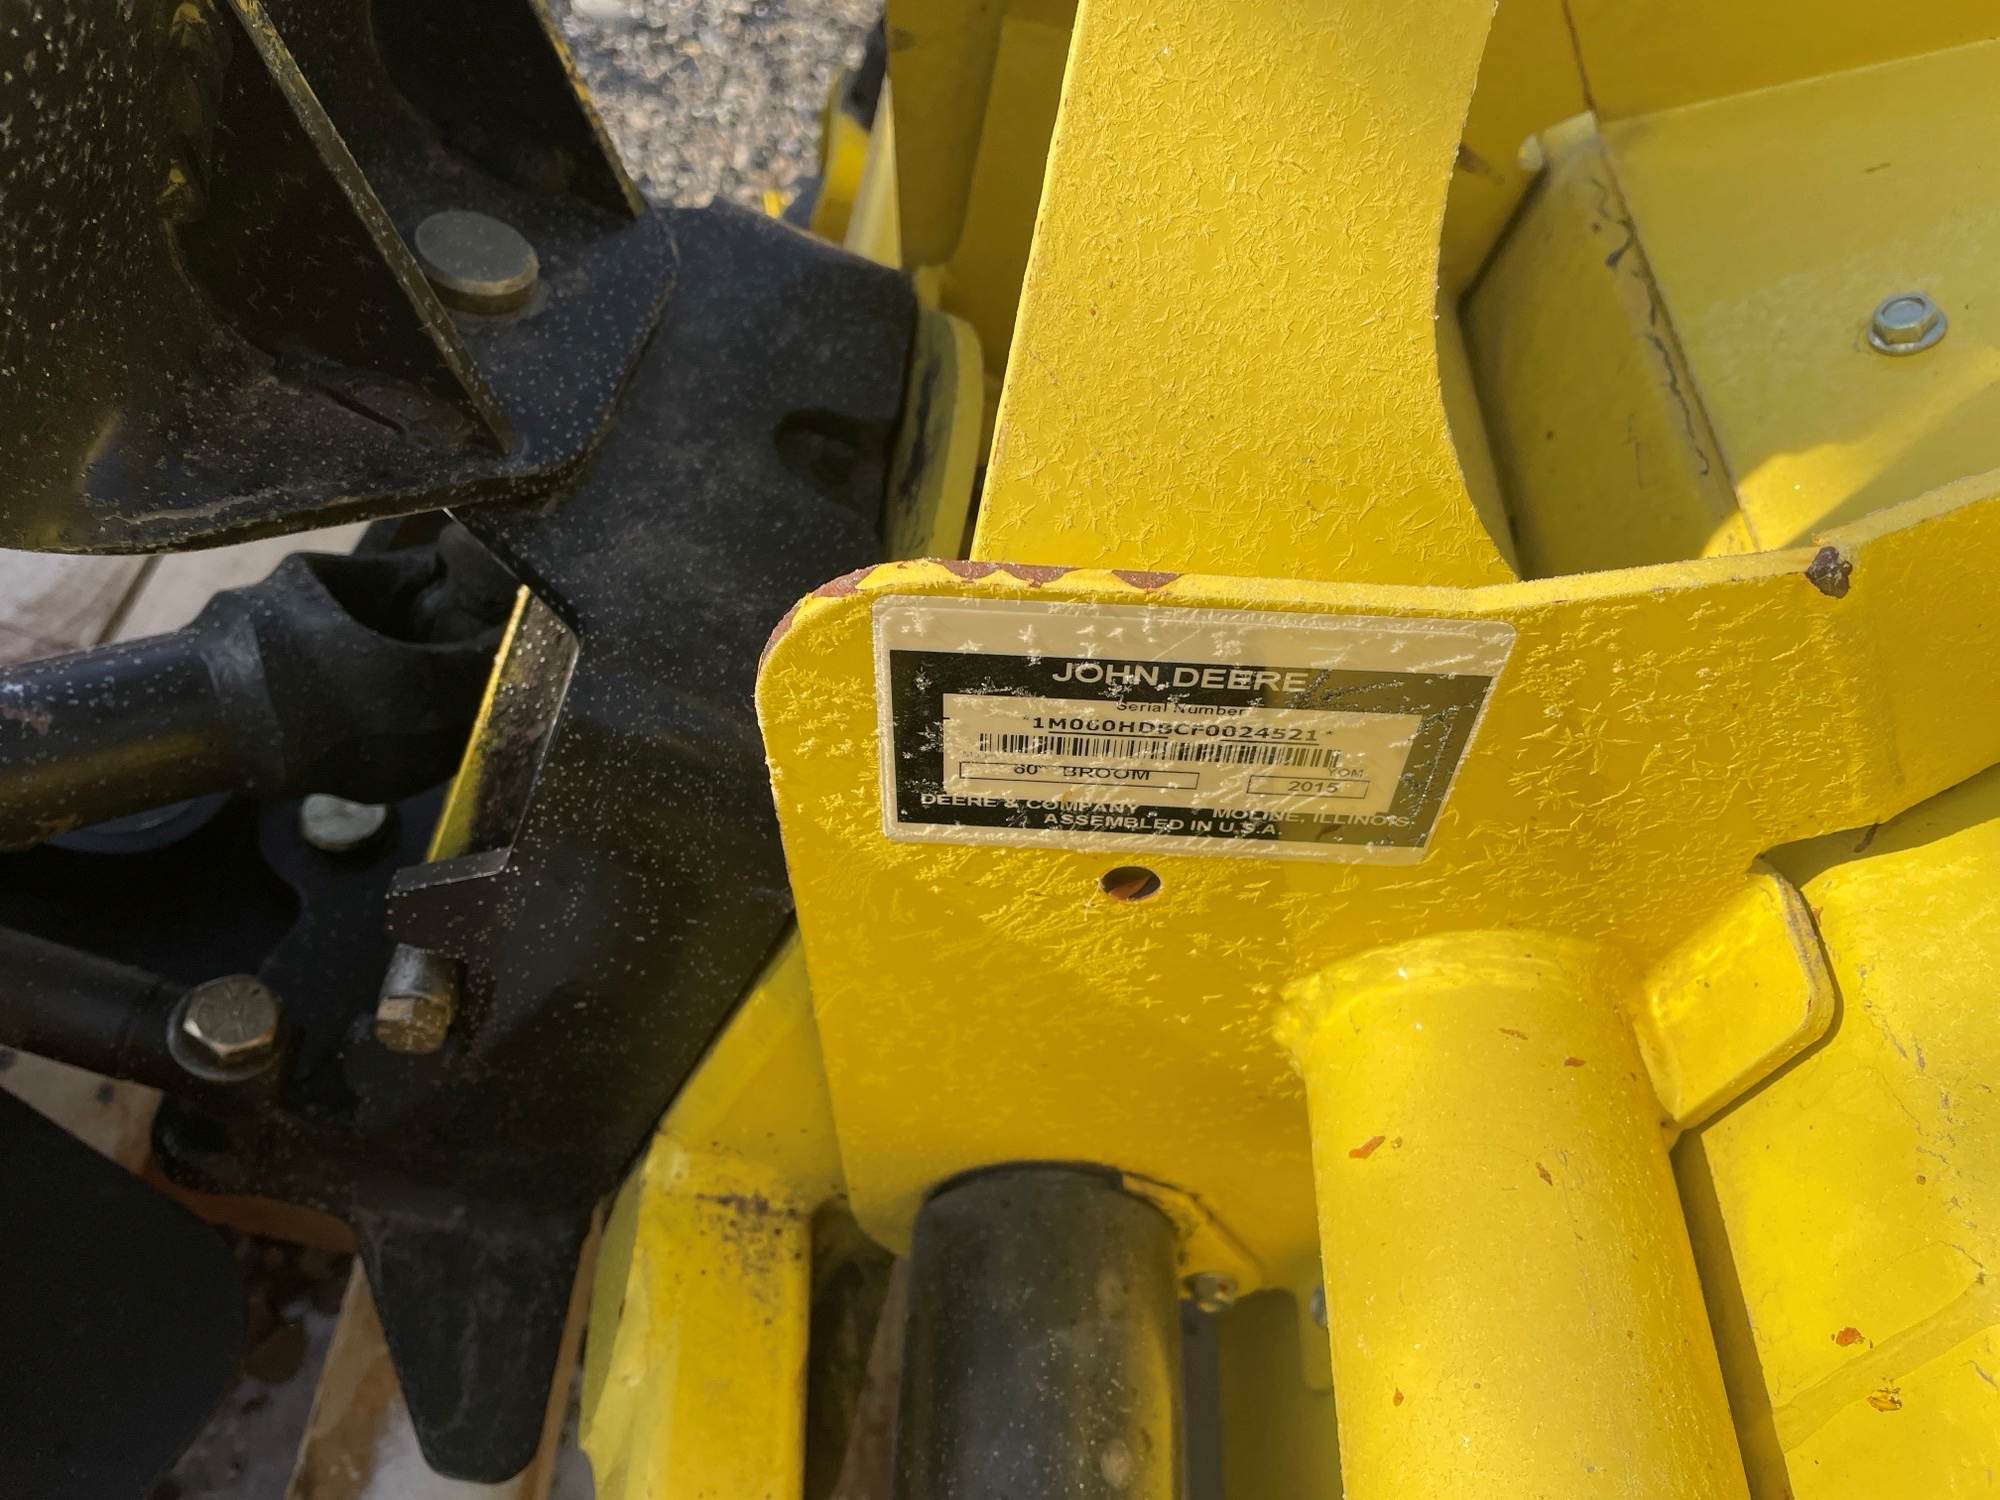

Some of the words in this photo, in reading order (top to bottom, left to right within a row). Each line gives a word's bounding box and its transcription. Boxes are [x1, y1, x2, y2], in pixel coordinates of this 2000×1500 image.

[1052, 662, 1160, 687] JOHN
[1172, 667, 1309, 692] DEERE
[1117, 702, 1168, 712] Serial
[1174, 704, 1245, 716] Number
[1062, 766, 1151, 781] BROOM
[1288, 780, 1339, 793] 2015
[920, 793, 999, 808] DEERE
[1026, 799, 1140, 815] COMPANY
[1043, 813, 1185, 832] ASSEMBLED
[1190, 819, 1213, 832] IN
